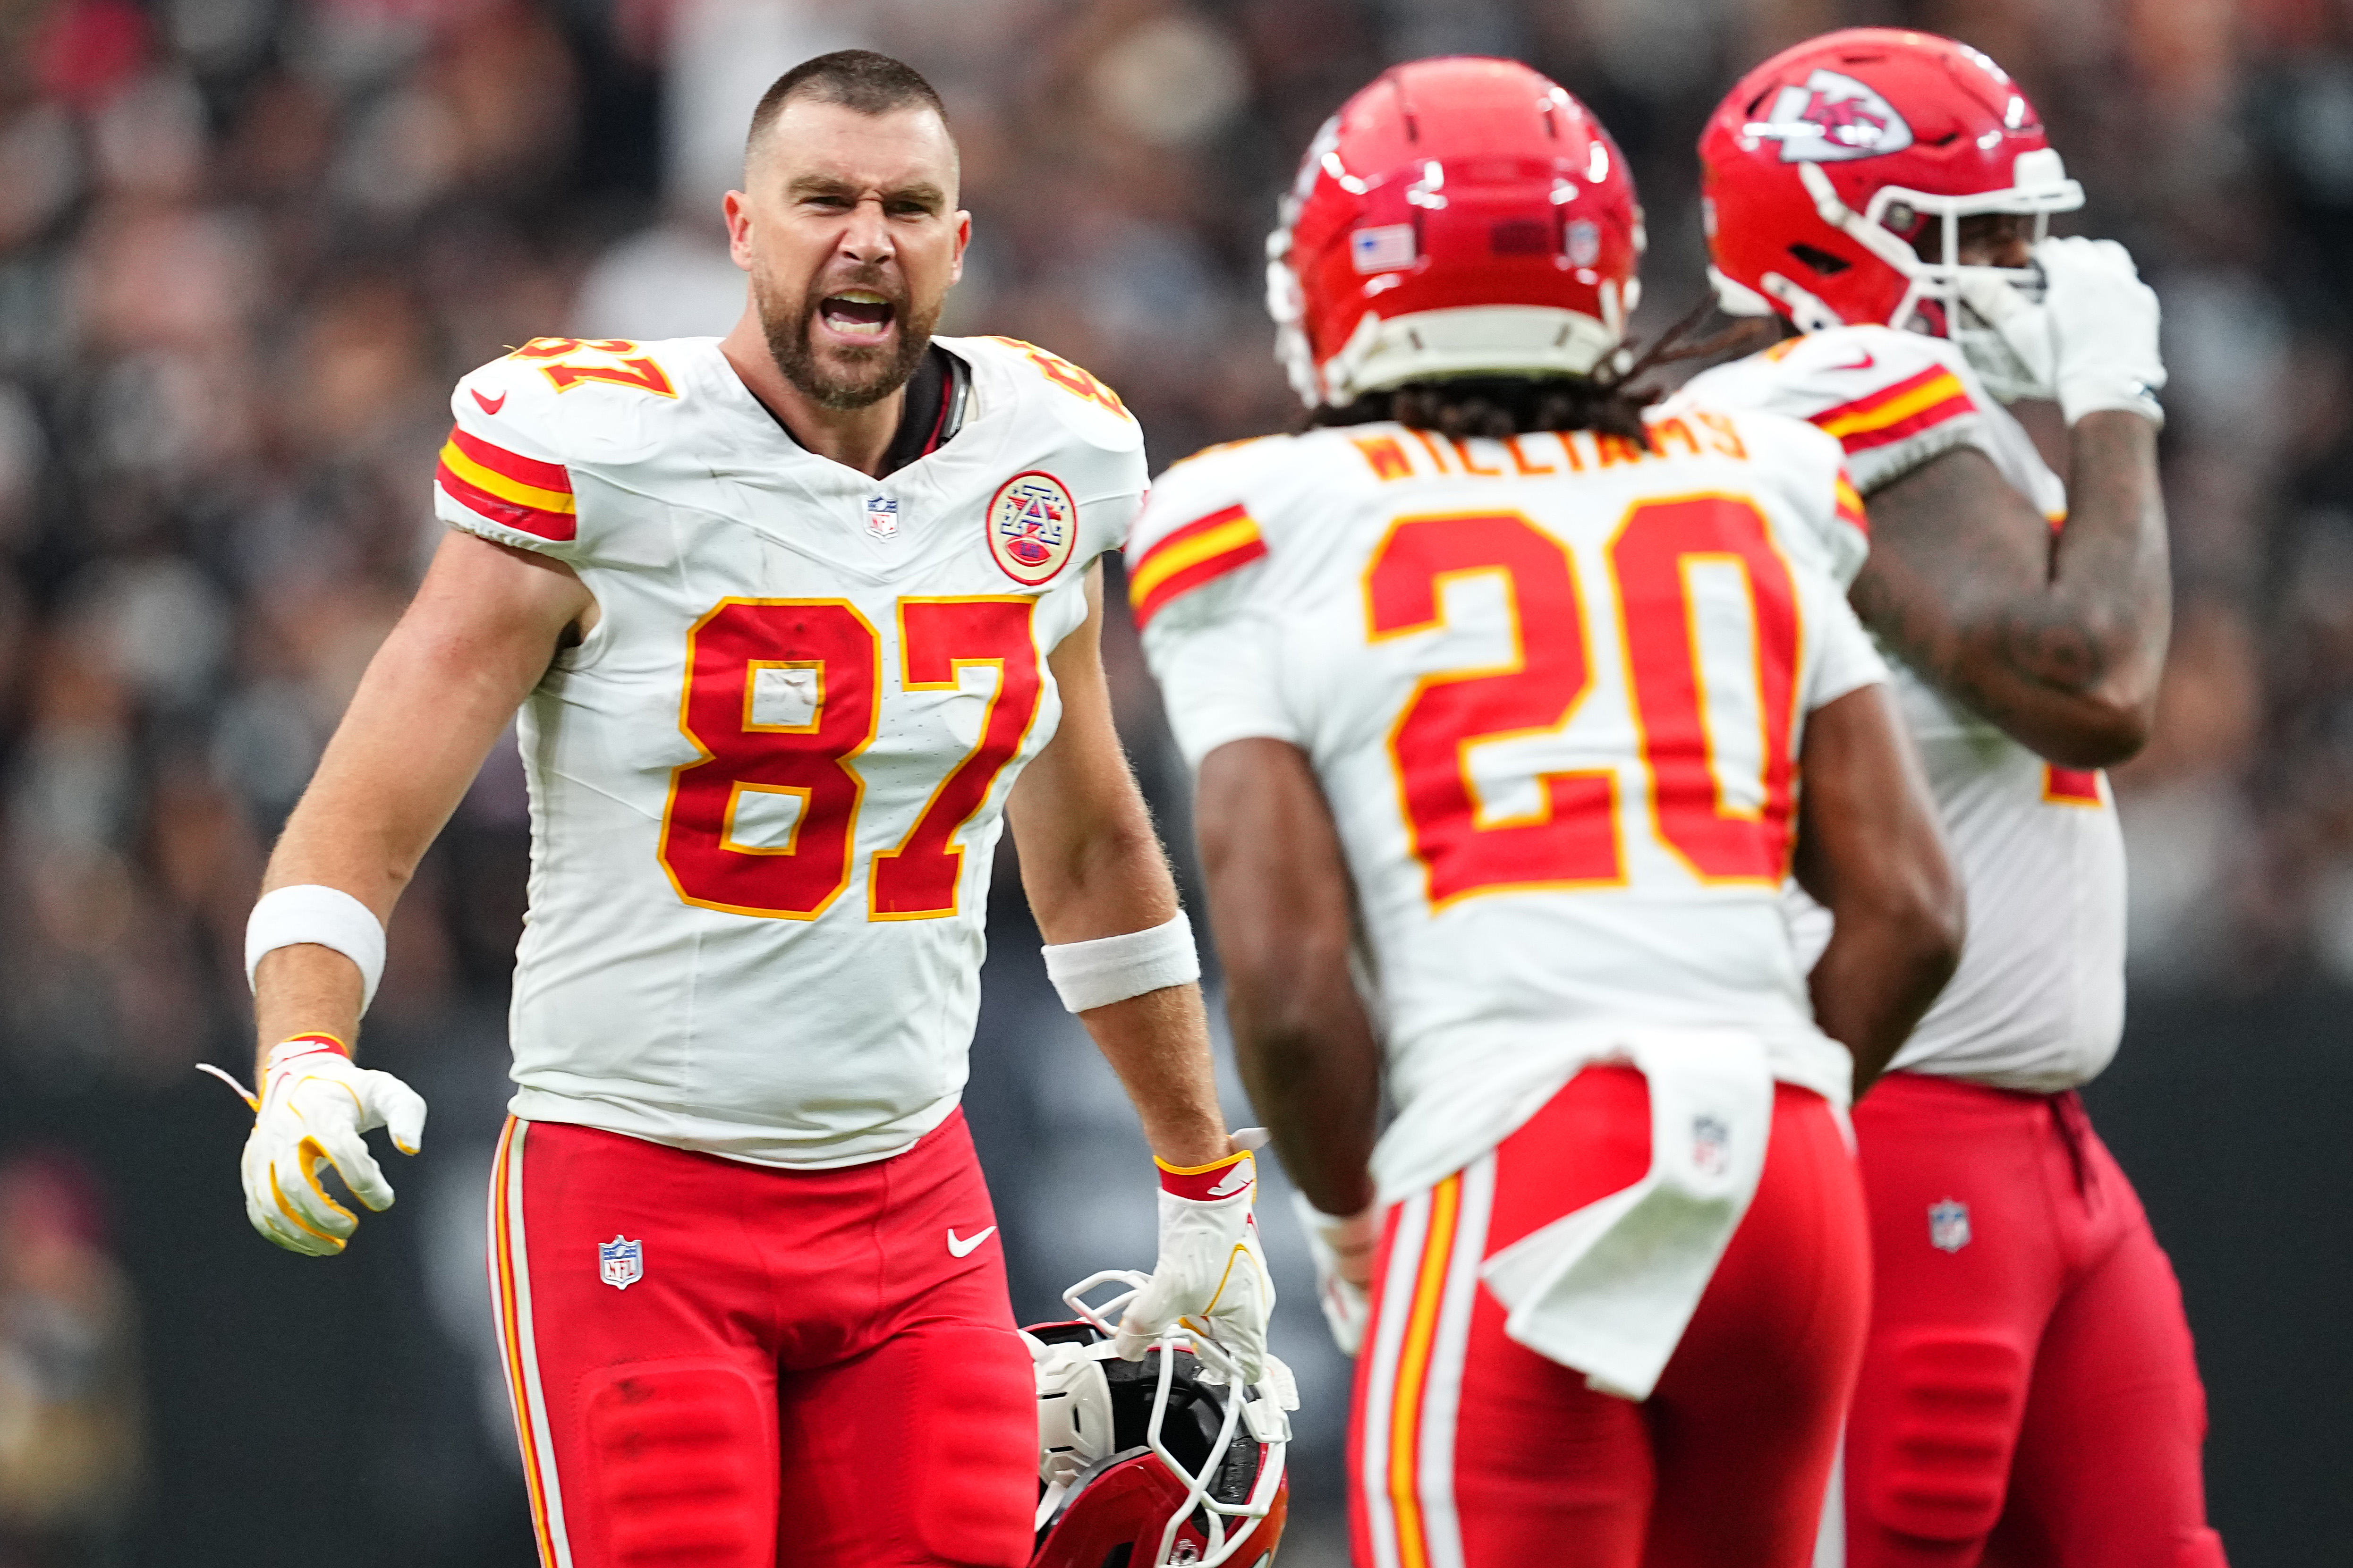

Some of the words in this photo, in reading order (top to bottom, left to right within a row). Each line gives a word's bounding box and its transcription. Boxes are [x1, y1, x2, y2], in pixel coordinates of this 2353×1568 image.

[657, 594, 1043, 922] 87
[1361, 492, 1804, 917] 20
[605, 1260, 636, 1279] NFL
